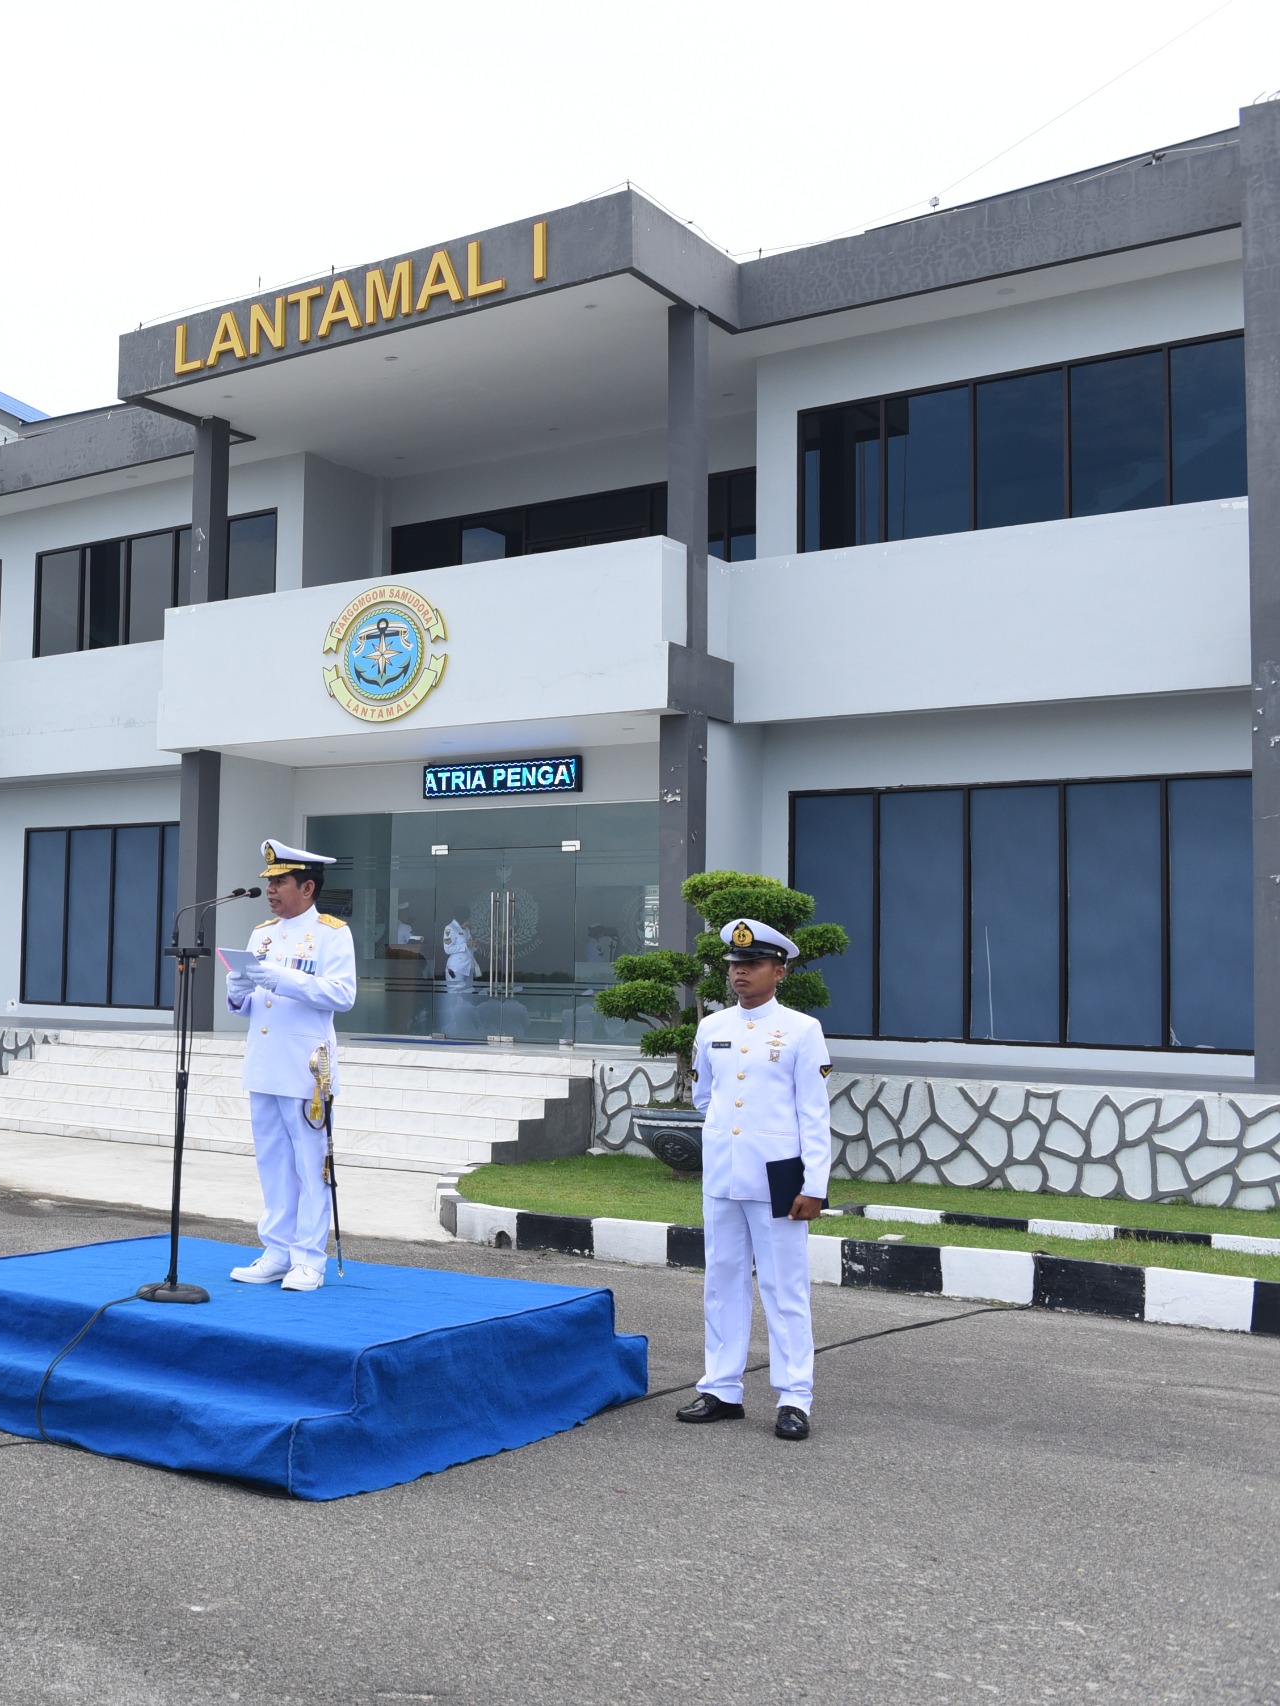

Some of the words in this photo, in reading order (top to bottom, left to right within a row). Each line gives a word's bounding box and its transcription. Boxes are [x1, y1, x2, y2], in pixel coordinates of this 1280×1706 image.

[173, 240, 506, 376] LANTAMAL
[532, 220, 547, 282] I
[335, 588, 386, 635] PARGOMGOM
[388, 588, 434, 626] SAMUDORA
[345, 698, 411, 719] LANTAMAL
[412, 692, 419, 700] I
[426, 769, 487, 792] ATRIA
